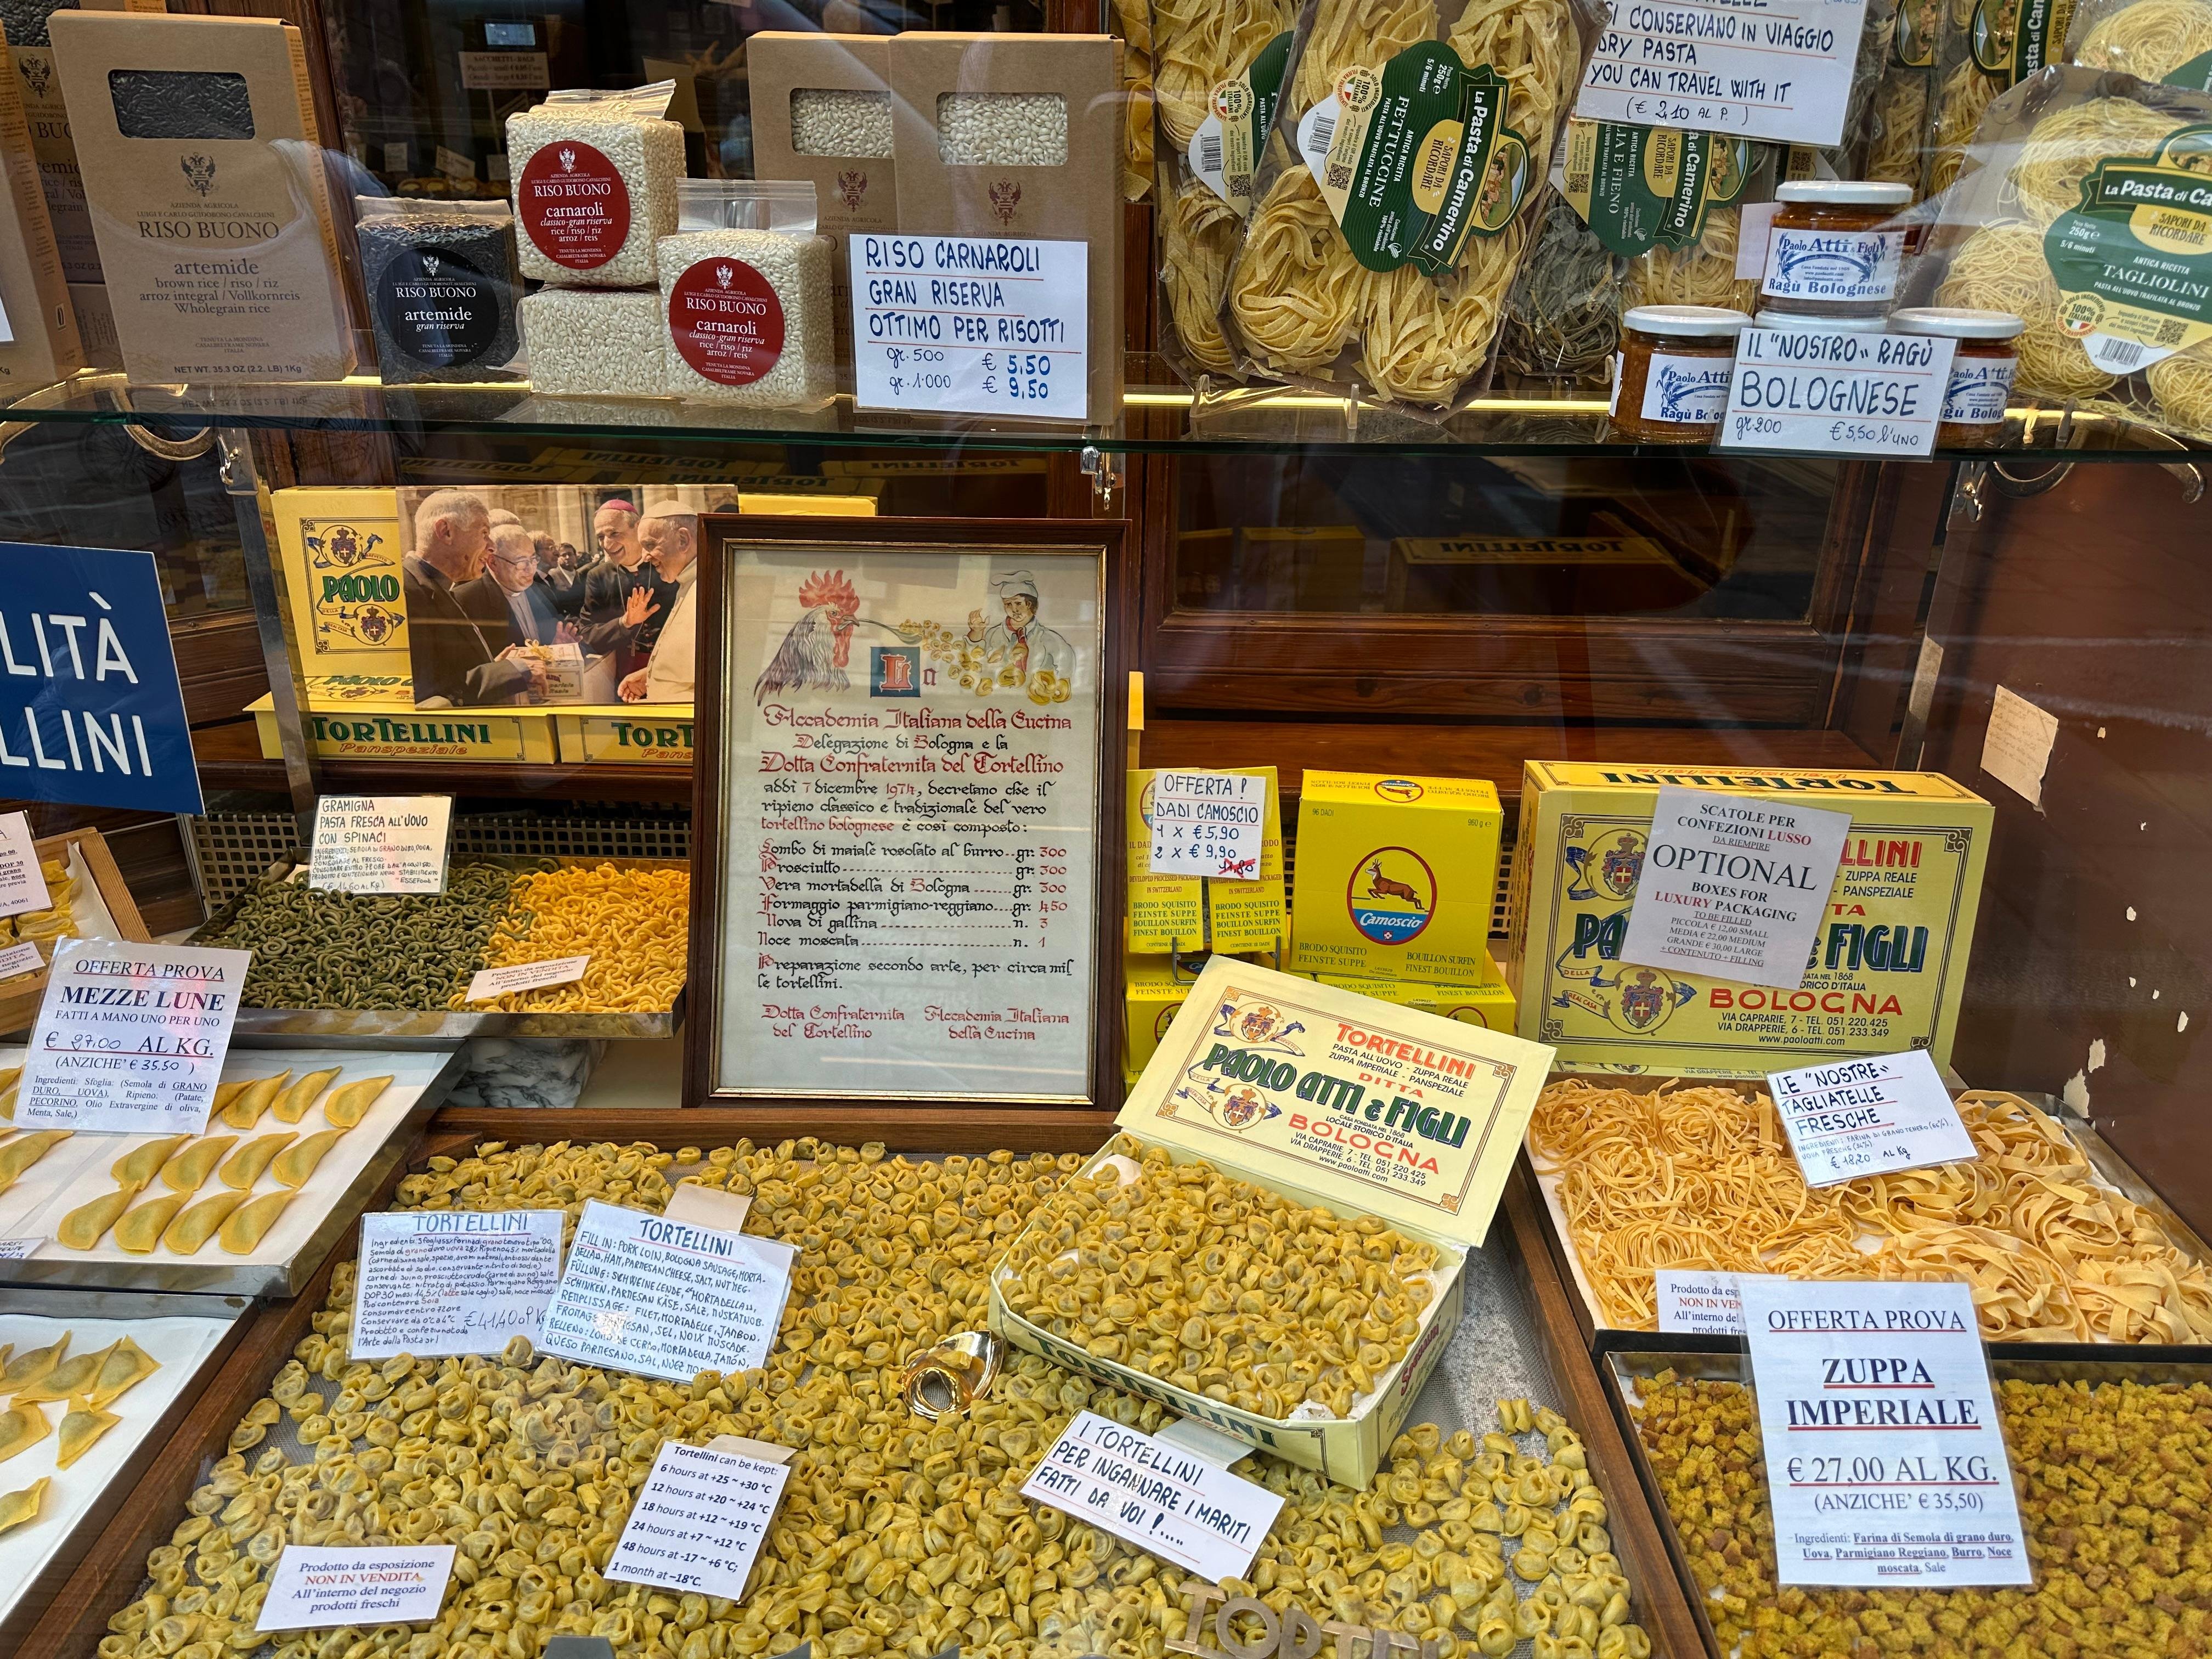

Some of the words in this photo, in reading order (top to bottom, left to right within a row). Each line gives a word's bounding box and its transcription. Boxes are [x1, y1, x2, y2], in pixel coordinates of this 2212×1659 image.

[1630, 4, 1735, 40] CONSERVANO
[1742, 23, 1756, 42] IN
[1767, 21, 1833, 52] VIAGGIO
[1599, 33, 1631, 58] DRY
[1643, 38, 1697, 65] PASTA
[1590, 64, 1623, 86] YOU
[1630, 67, 1662, 88] CAN
[1668, 72, 1722, 97] TRAVEL
[1731, 79, 1766, 100] WITH
[1774, 82, 1791, 102] IT
[1475, 91, 1485, 104] La
[1465, 105, 1488, 154] Pasta
[1369, 95, 1410, 207] FETTUCCINE
[1438, 145, 1453, 178] SAPORI
[1464, 155, 1473, 167] di
[1420, 139, 1443, 191] RICORDARE
[534, 185, 563, 197] RISO
[566, 184, 611, 195] BUONO
[1434, 177, 1444, 188] DA
[2105, 185, 2118, 195] La
[2120, 180, 2174, 200] Pasta
[2174, 191, 2187, 200] di
[546, 202, 604, 217] carnaroli
[1434, 168, 1474, 251] Camerino
[140, 221, 192, 239] RISO
[198, 221, 279, 239] BUONO
[540, 218, 585, 227] classico-gran
[866, 238, 924, 268] RISO
[935, 240, 1040, 271] CARNAROLI
[1782, 237, 1807, 252] Paolo
[1808, 236, 1850, 253] Atti
[1857, 239, 1880, 253] Figli
[174, 259, 259, 275] artemide
[397, 287, 426, 297] RISO
[429, 287, 476, 297] BUONO
[1769, 278, 1801, 293] Ragù
[1808, 280, 1886, 297] Bolognese
[2102, 264, 2210, 298] TAGLIOLINI
[869, 280, 917, 305] GRAN
[933, 280, 1004, 307] RISERVA
[174, 303, 247, 317] Wholegrain
[250, 304, 270, 314] rice
[405, 307, 472, 321] artemide
[416, 323, 435, 332] gran
[437, 321, 465, 330] riserva
[870, 312, 941, 340] OTTIMO
[954, 317, 988, 342] PER
[998, 318, 1064, 343] RISOTTI
[1747, 333, 1762, 358] IL
[1878, 338, 1934, 366] RAGÙ
[213, 365, 233, 374] 35.3
[235, 365, 245, 373] OZ
[268, 365, 283, 374] LB)
[285, 365, 301, 375] 1Kg
[913, 349, 944, 362] 500
[982, 353, 997, 371] €
[1008, 356, 1050, 376] 5,50
[983, 377, 998, 393] €
[1009, 377, 1048, 400] 9,50
[1741, 371, 1918, 416] BOLOGNESE
[1830, 422, 1845, 440] €
[1846, 425, 1875, 442] 5,50
[323, 575, 400, 602] PAOLO
[0, 592, 138, 683] LITÀ
[313, 716, 493, 744] TORTELLINI
[882, 708, 962, 730] Italiana
[966, 708, 1007, 729] della
[340, 743, 468, 756] Panspeziale
[941, 756, 968, 774] del
[1164, 775, 1235, 797] OFFERTA
[323, 800, 374, 812] GRAMIGNA
[1156, 804, 1190, 817] DADI
[1197, 804, 1259, 823] CAMOSCIO
[320, 816, 345, 828] PASTA
[351, 815, 384, 828] FRESCA
[319, 833, 336, 844] CON
[345, 832, 386, 843] SPINACI
[1653, 844, 1818, 891] OPTIONAL
[1691, 881, 1737, 900] BOXES
[1740, 888, 1768, 904] FOR
[1655, 890, 1712, 909] LUXURY
[1714, 900, 1797, 923] PACKAGING
[1360, 912, 1423, 929] Camoscio
[1299, 942, 1326, 954] BRODO
[1328, 944, 1367, 956] SQUISITO
[1826, 923, 1928, 974] FIGLI
[76, 960, 156, 976] OFFERTA
[162, 964, 224, 980] PROVA
[1298, 954, 1335, 966] FEINSTE
[1338, 957, 1367, 968] SUPPE
[60, 986, 150, 1008] MEZZE
[155, 990, 225, 1012] LUNE
[1709, 989, 1903, 1016] BOLOGNA
[1337, 1022, 1476, 1080] TORTELLINI
[1758, 1034, 1845, 1046] www.paoloatti.com
[1203, 1043, 1296, 1091] PAOLO
[1296, 1071, 1367, 1116] ATTI
[1384, 1096, 1472, 1149] FIGLI
[1777, 1076, 1801, 1096] LE
[1782, 1085, 1884, 1116] TAGLIATELLE
[1795, 1108, 1880, 1135] FRESCHE
[1288, 1114, 1439, 1175] BOLOGNA
[413, 1213, 527, 1232] TORTELLINI
[640, 1218, 734, 1255] TORTELLINI
[1769, 1310, 1879, 1330] OFFERTA
[1884, 1310, 1966, 1329] PROVA
[1822, 1358, 1933, 1383] ZUPPA
[1786, 1400, 1978, 1425] IMPERIALE
[674, 1446, 718, 1462] Tortellini
[719, 1455, 736, 1466] can
[738, 1458, 752, 1469] be
[753, 1462, 778, 1476] kept:
[1096, 1426, 1204, 1486] TORTELLINI
[1787, 1457, 1803, 1482] €
[1810, 1458, 1884, 1486] 27,00
[1895, 1457, 1937, 1481] AL
[1945, 1457, 1998, 1481] KG.
[1036, 1466, 1081, 1496] FATTI
[1088, 1488, 1110, 1508] DA
[1120, 1501, 1146, 1523] VOI
[1053, 1440, 1090, 1469] PER
[1091, 1457, 1182, 1510] INGANNARE
[1195, 1503, 1251, 1544] MARITI
[300, 1562, 349, 1572] Prodotto
[352, 1561, 365, 1570] da
[369, 1560, 435, 1571] esposizione
[305, 1575, 337, 1585] NON
[341, 1575, 355, 1583] IN
[360, 1572, 421, 1582] VENDITA
